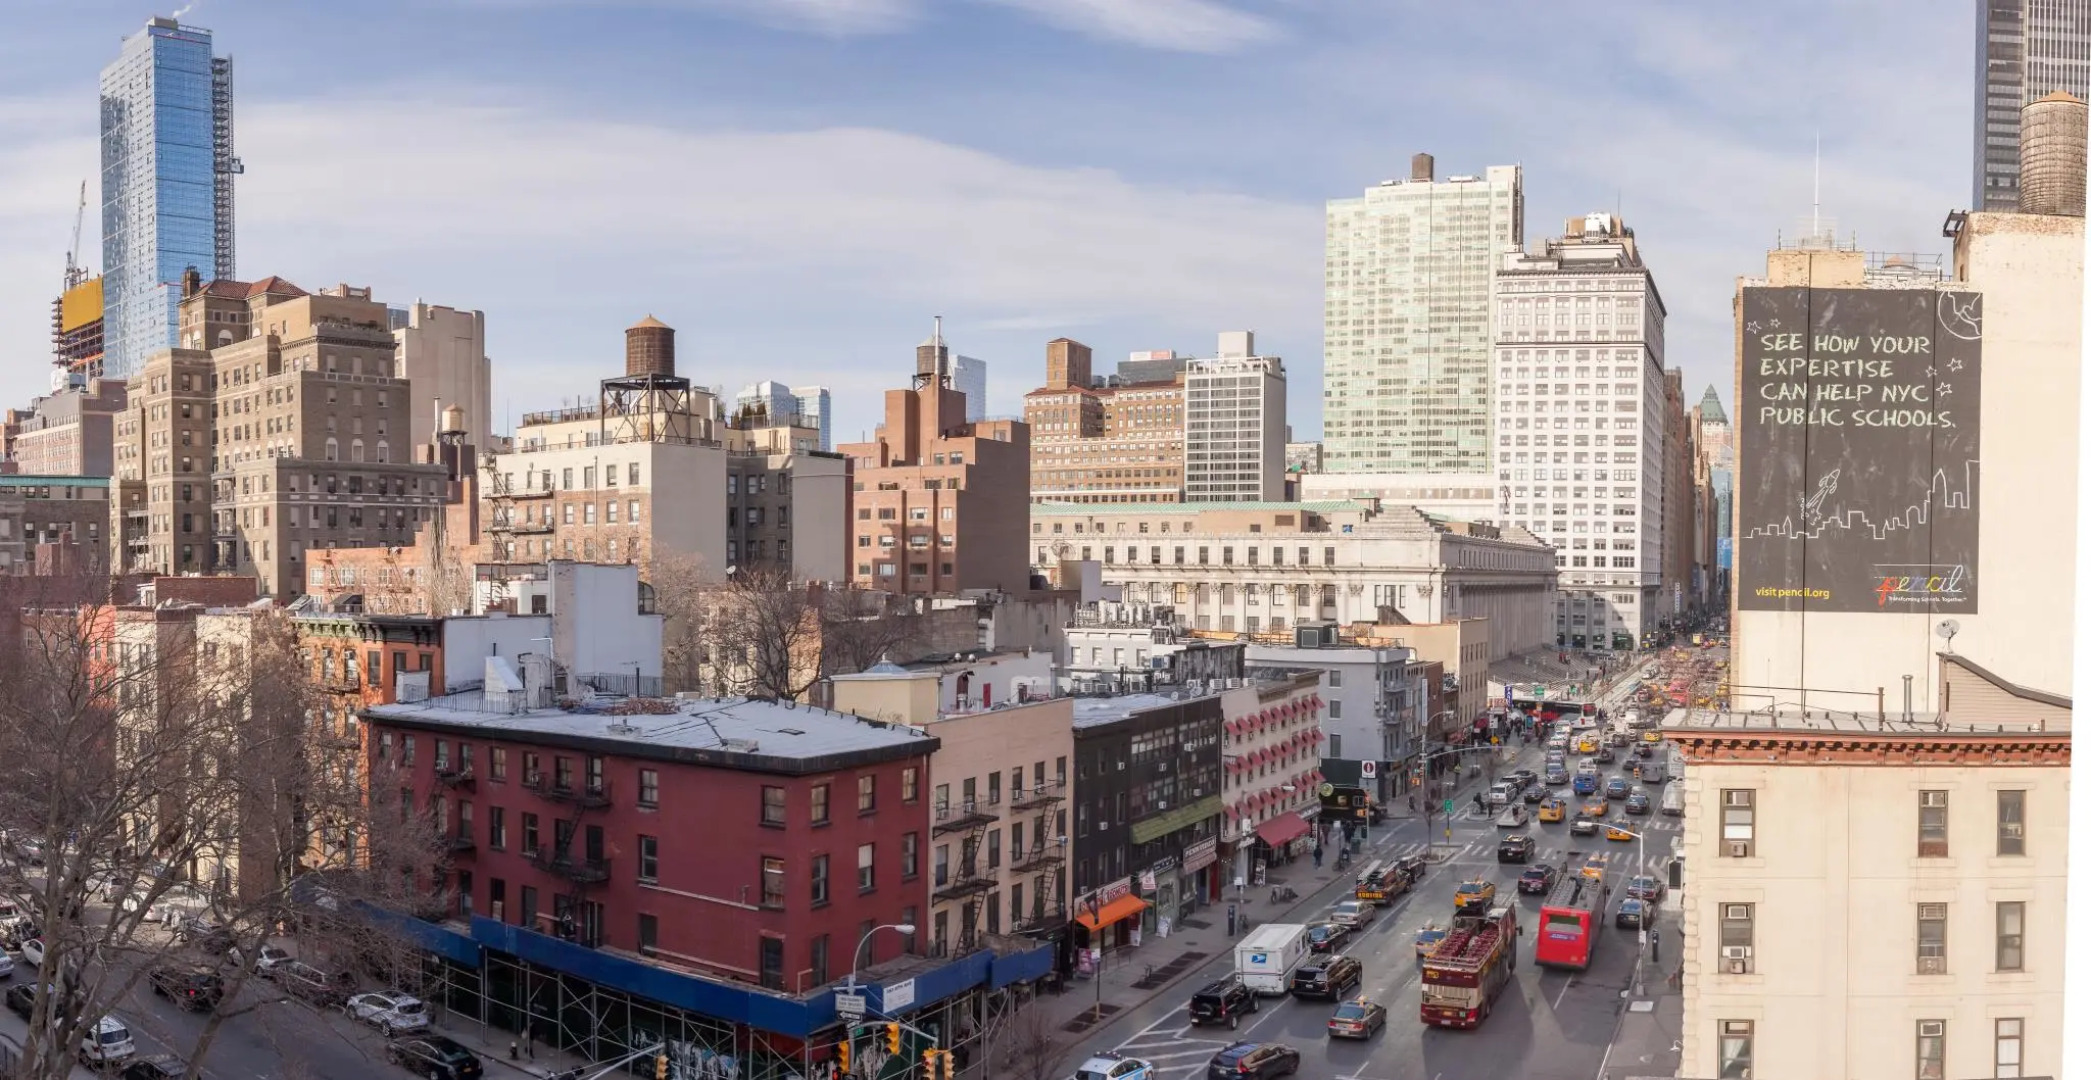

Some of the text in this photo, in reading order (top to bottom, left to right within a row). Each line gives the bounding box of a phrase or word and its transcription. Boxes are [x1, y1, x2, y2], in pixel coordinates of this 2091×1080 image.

[1760, 333, 1931, 353] SEE HOW YOUR
[1760, 357, 1894, 378] EXPERTISE
[1760, 382, 1929, 402] CAN HELP NYC
[1760, 407, 1957, 428] PUBLIC SCHOOLS.
[1755, 586, 1830, 600] visit pencil.org
